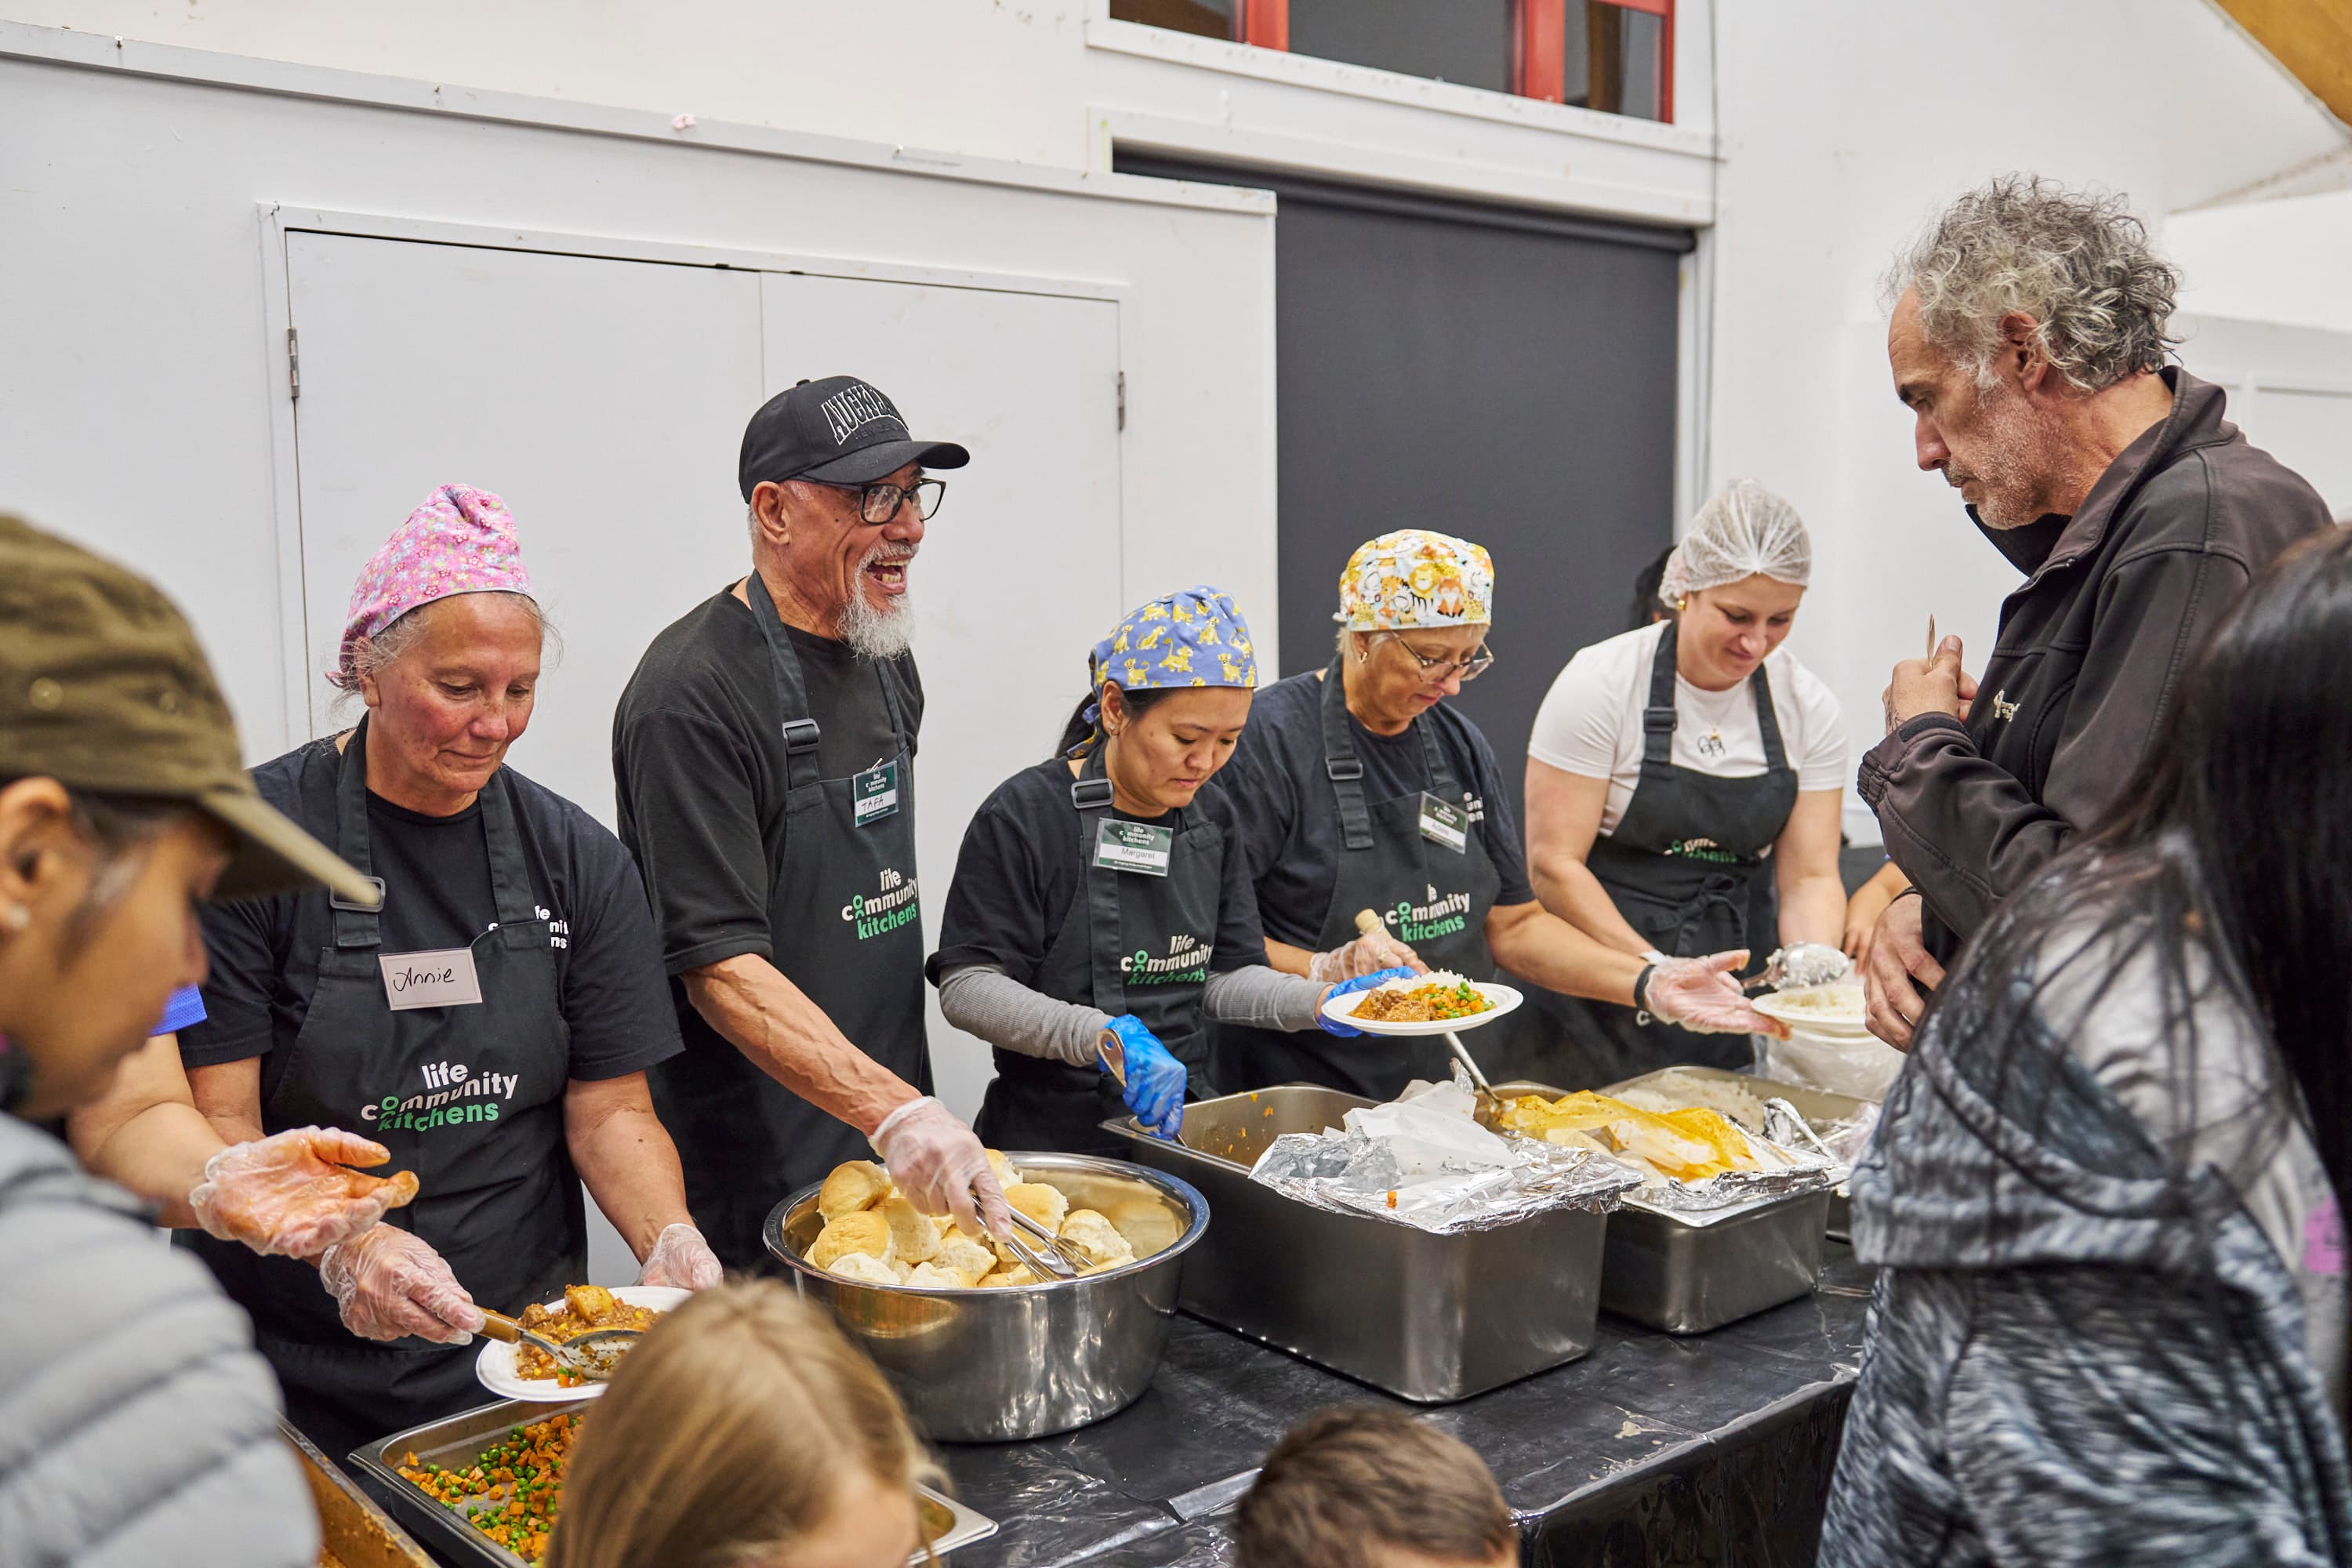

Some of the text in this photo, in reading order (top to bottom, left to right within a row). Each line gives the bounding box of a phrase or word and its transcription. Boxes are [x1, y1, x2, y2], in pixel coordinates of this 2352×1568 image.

[1119, 829, 1155, 841] community
[1123, 836, 1150, 845] kitchens
[1121, 848, 1155, 859] Margaret
[841, 877, 918, 921] community
[857, 902, 916, 940] kitchens
[1120, 943, 1214, 973] community
[1169, 934, 1195, 955] life
[393, 967, 456, 992] Annie
[1127, 967, 1205, 985] kitchens
[421, 1060, 468, 1090] life
[361, 1070, 518, 1121] community
[377, 1102, 499, 1133] kitchens
